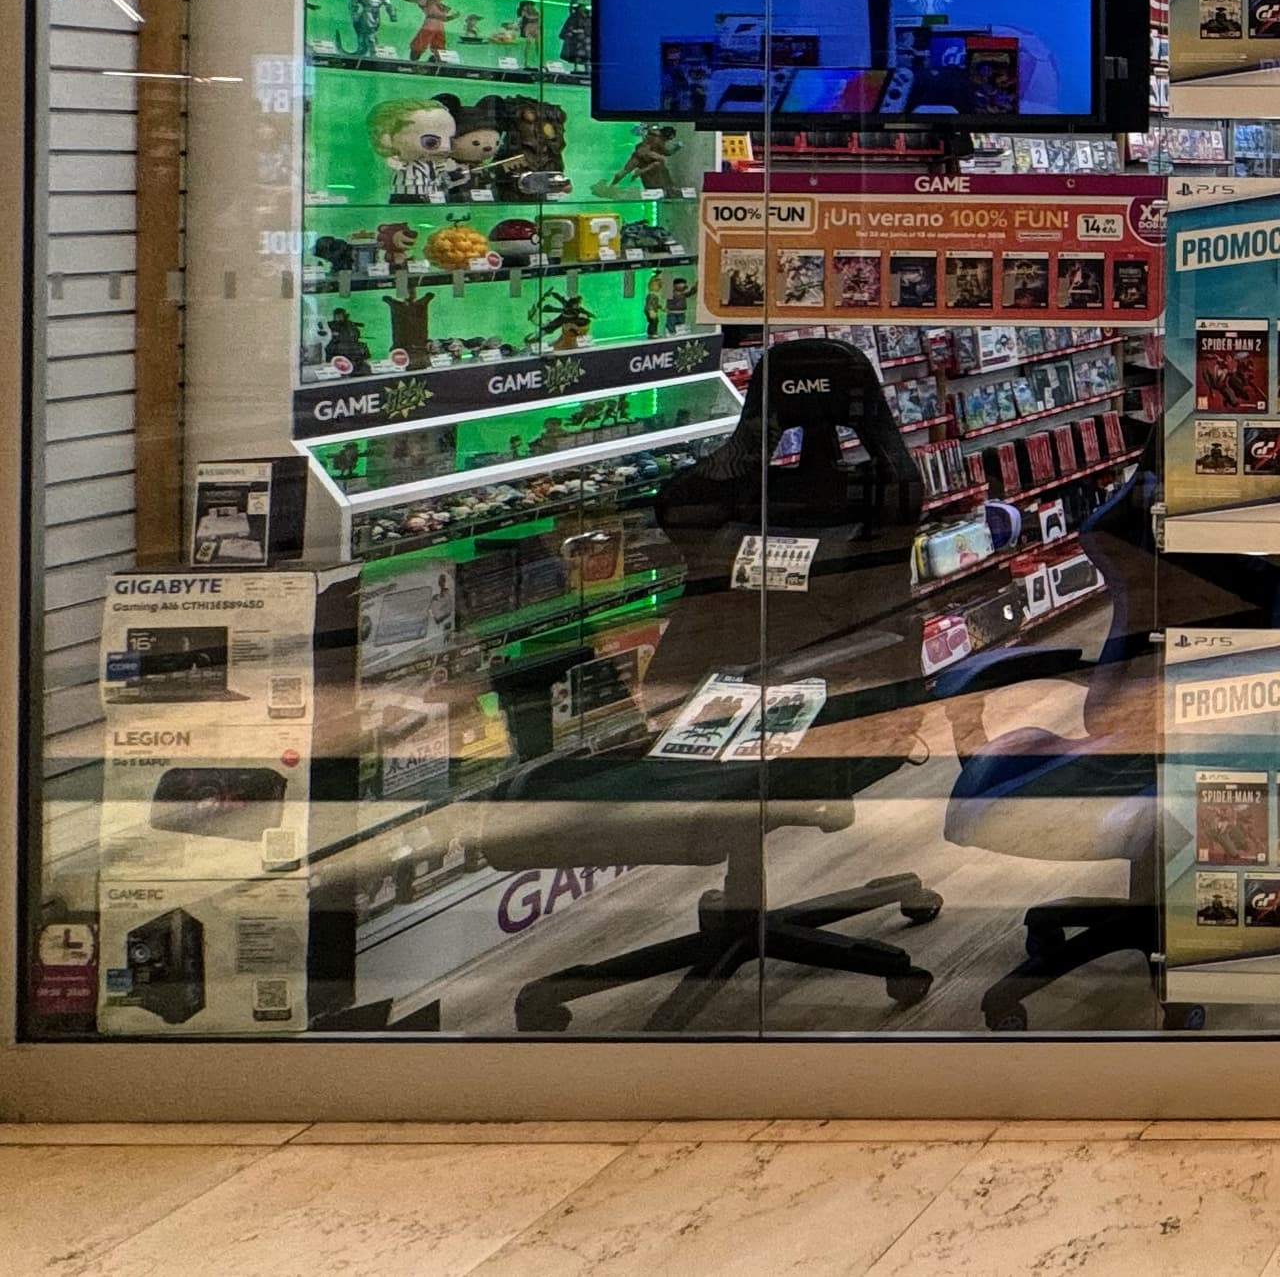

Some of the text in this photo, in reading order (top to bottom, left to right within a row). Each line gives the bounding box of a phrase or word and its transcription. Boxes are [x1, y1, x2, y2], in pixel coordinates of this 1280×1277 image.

[914, 177, 971, 194] GAME
[1196, 183, 1235, 195] PS5
[712, 206, 805, 222] 100% FUN
[823, 207, 1069, 229] ¡Un verano 100% FUN!
[629, 351, 673, 373] GAME
[488, 370, 543, 395] GAME
[781, 377, 831, 394] GAME
[314, 393, 381, 422] GAME
[114, 578, 223, 595] GIGABYTE
[112, 601, 158, 613] Gaming
[1194, 636, 1233, 648] PS5
[113, 731, 191, 747] LEGION
